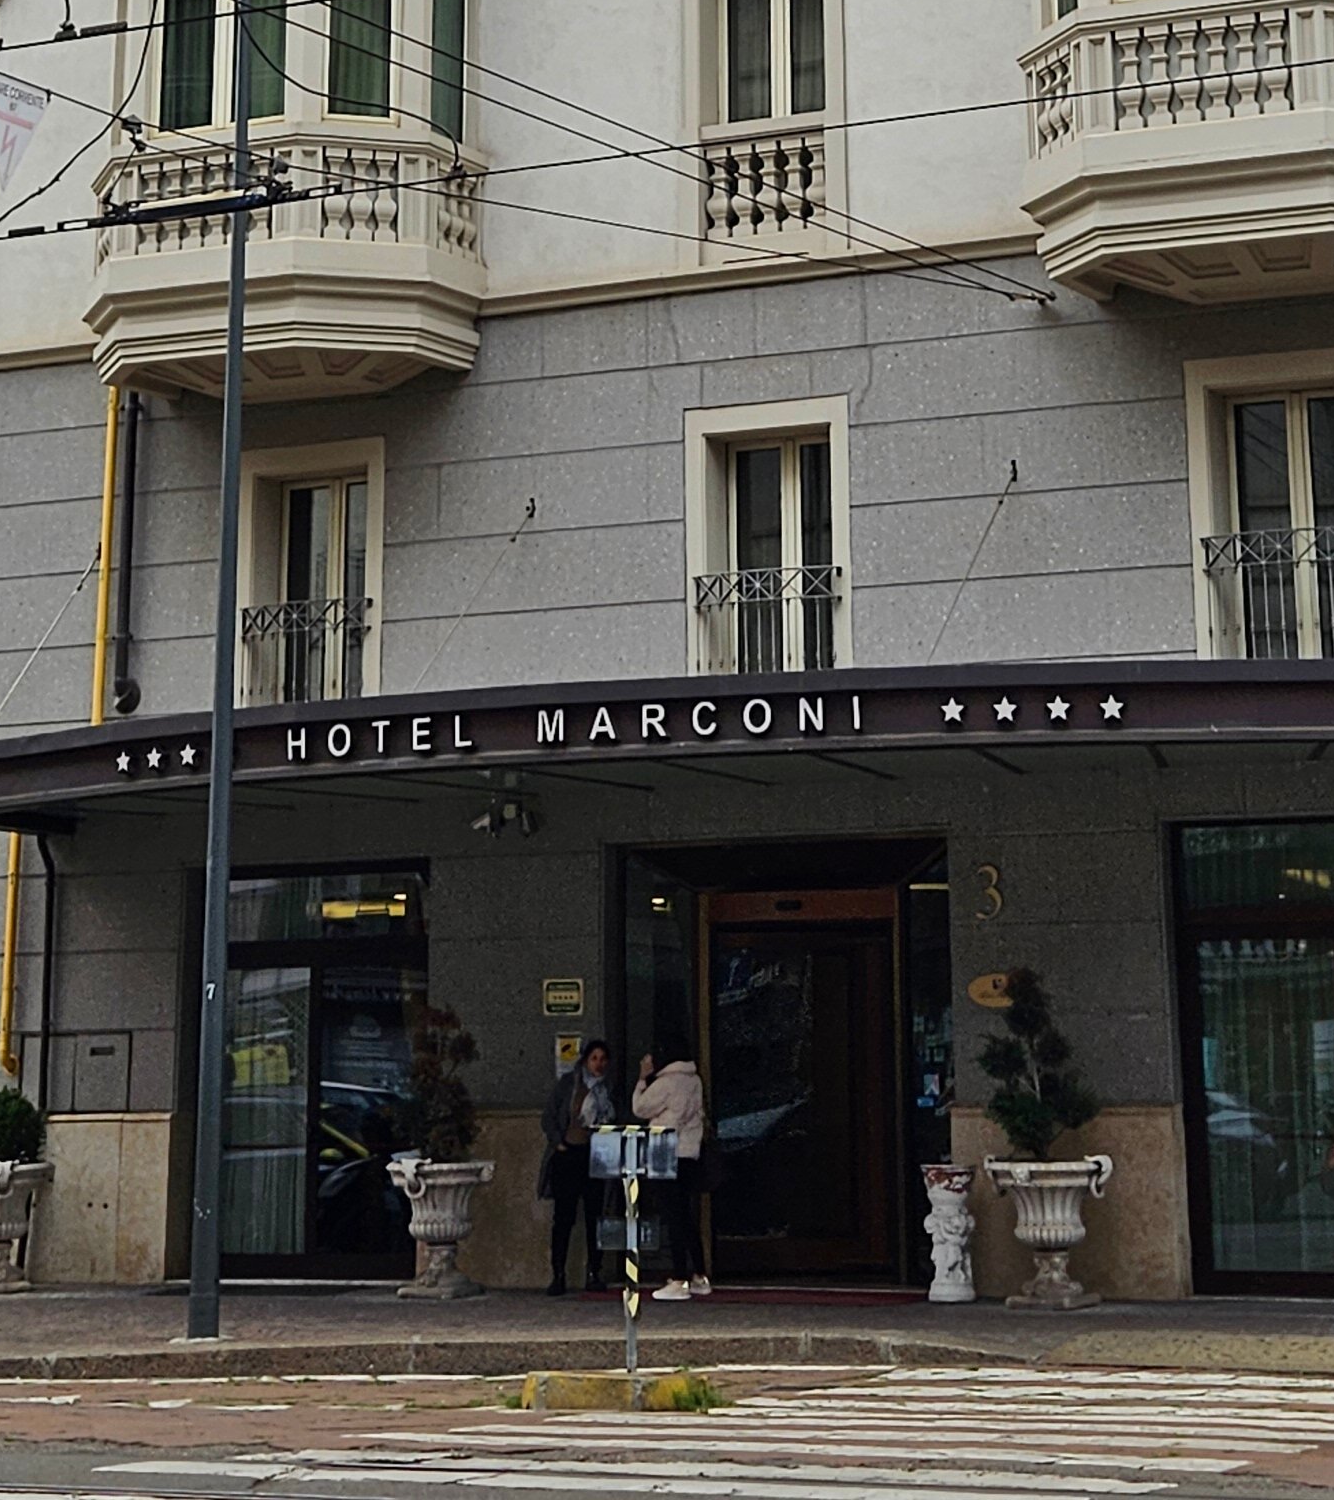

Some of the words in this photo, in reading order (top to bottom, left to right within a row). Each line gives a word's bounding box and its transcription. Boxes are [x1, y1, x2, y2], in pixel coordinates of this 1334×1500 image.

[286, 714, 473, 762] HOTEL
[536, 695, 862, 745] MARCONI
[976, 864, 1003, 920] 3
